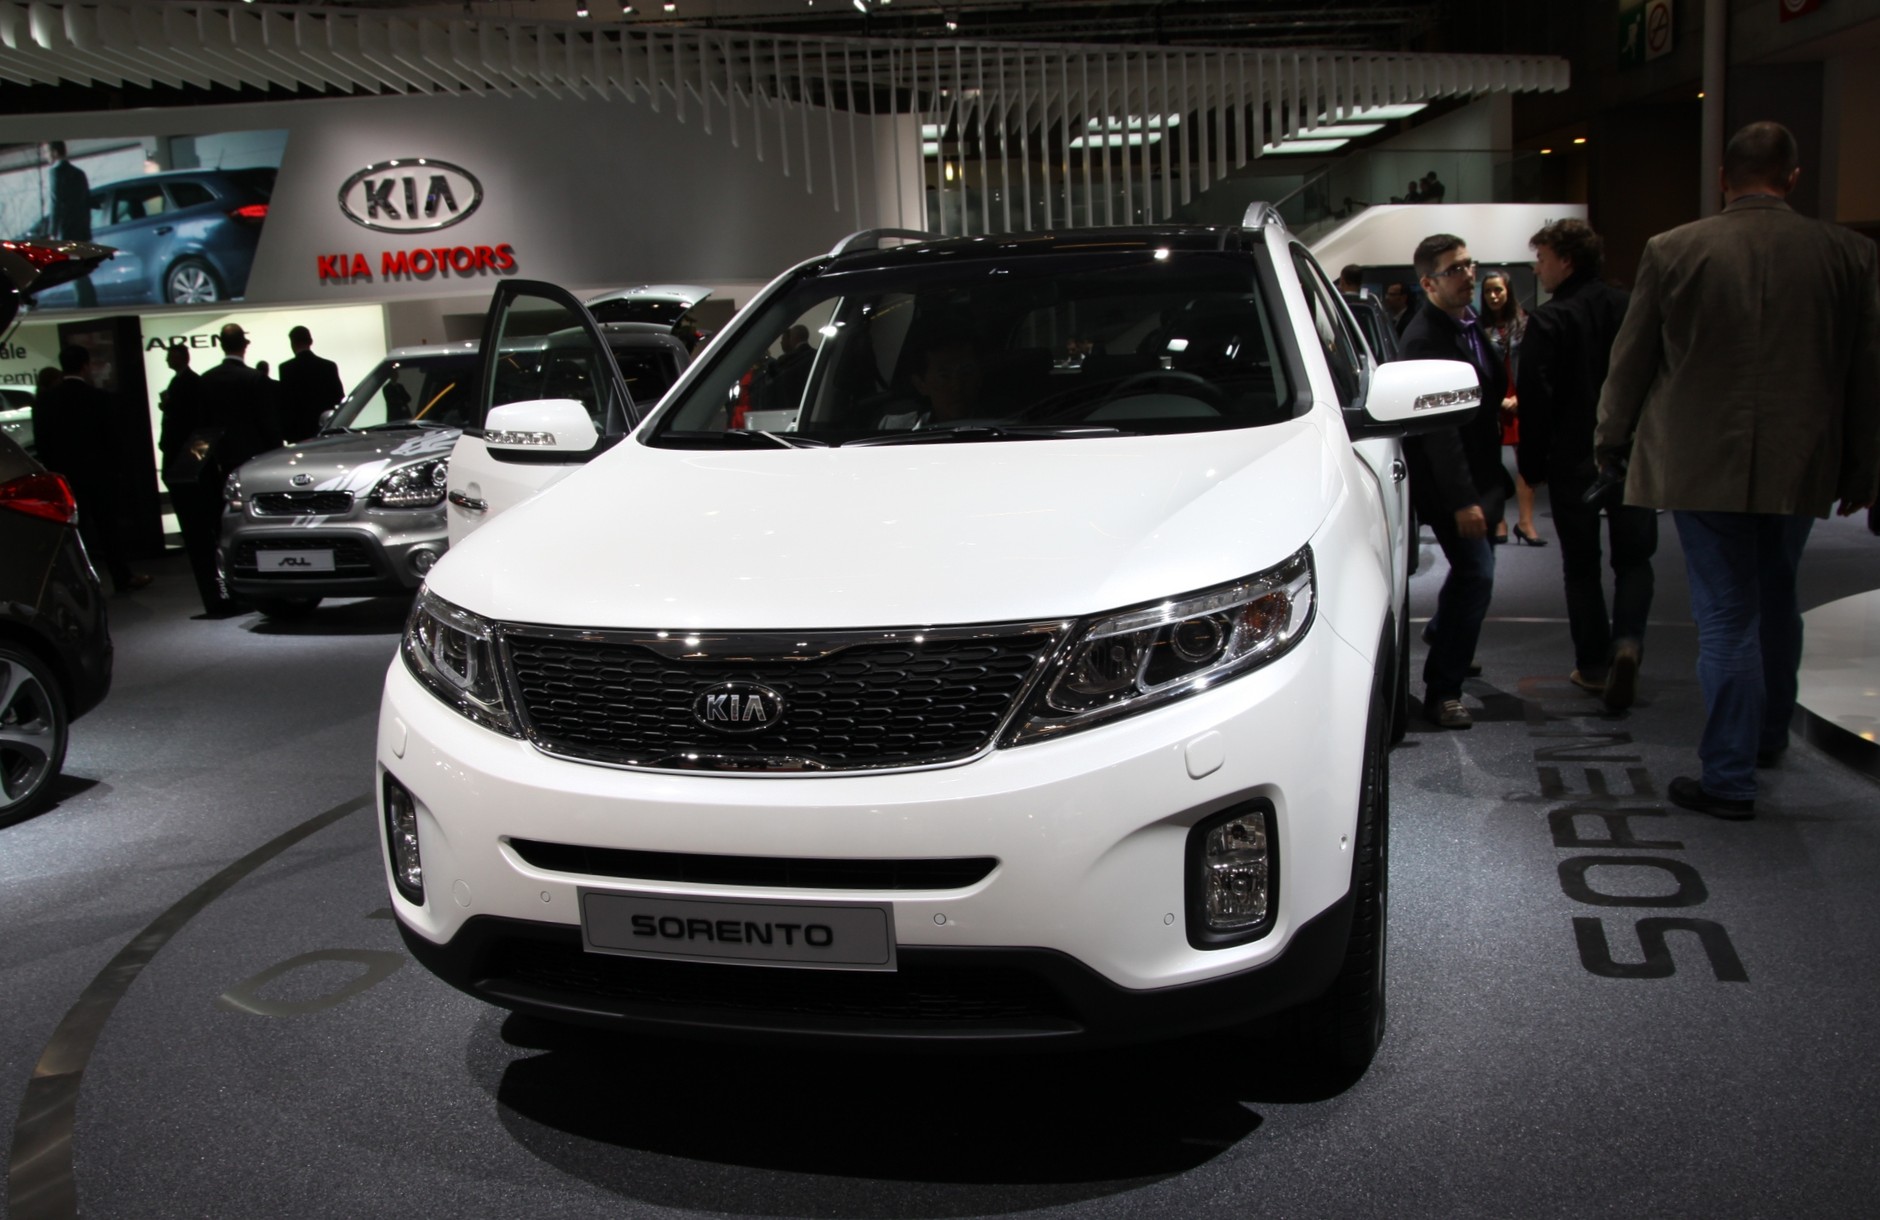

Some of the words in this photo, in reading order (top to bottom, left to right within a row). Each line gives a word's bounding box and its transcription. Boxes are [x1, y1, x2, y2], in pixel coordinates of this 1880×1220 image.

[362, 174, 459, 219] KIA
[317, 251, 372, 279] KIA
[381, 243, 515, 276] MOTORS
[706, 694, 767, 721] KIA
[631, 914, 834, 947] SORENTO
